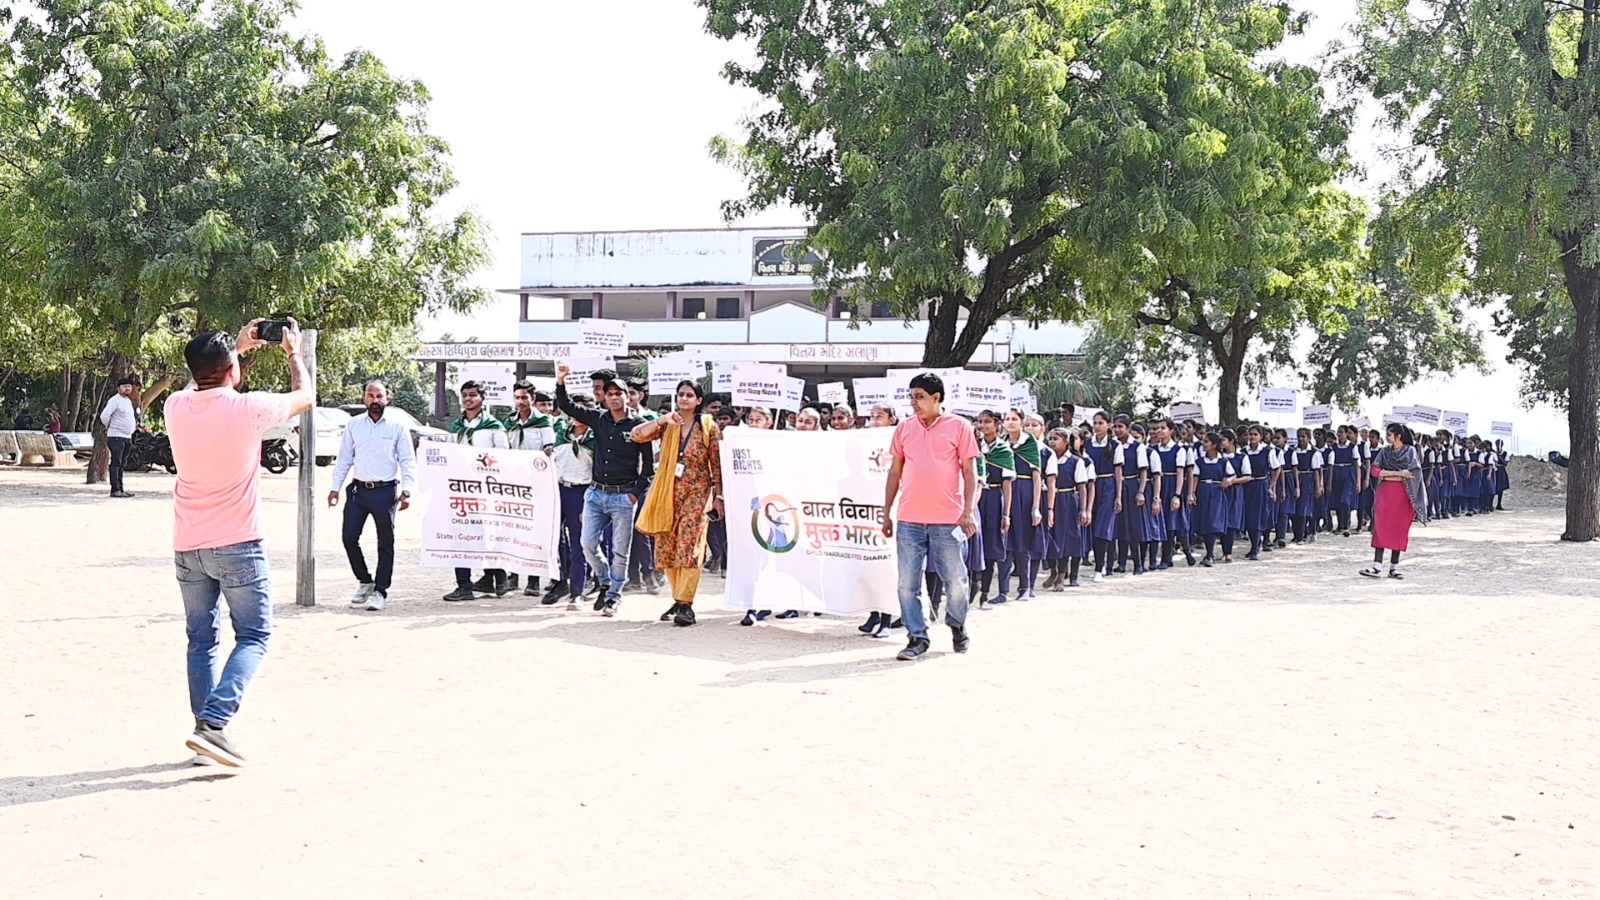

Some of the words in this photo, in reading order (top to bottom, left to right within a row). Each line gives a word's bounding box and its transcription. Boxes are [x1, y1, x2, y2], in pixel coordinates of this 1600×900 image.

[790, 344, 816, 358] વિનય
[820, 344, 842, 358] મંદિર
[846, 346, 878, 362] મલાણા
[426, 456, 448, 464] RIGHTS
[732, 448, 751, 460] JUST
[733, 459, 763, 470] RIGHTS
[448, 478, 482, 494] बाल
[485, 476, 533, 501] विवाह
[449, 496, 487, 518] मुक्त
[494, 500, 535, 518] भारत
[802, 501, 836, 518] बाल
[838, 497, 885, 525] विवाह
[436, 532, 454, 540] State
[458, 533, 484, 542] Gujarat
[804, 522, 840, 550] मुक्त
[863, 554, 892, 562] BHARAT
